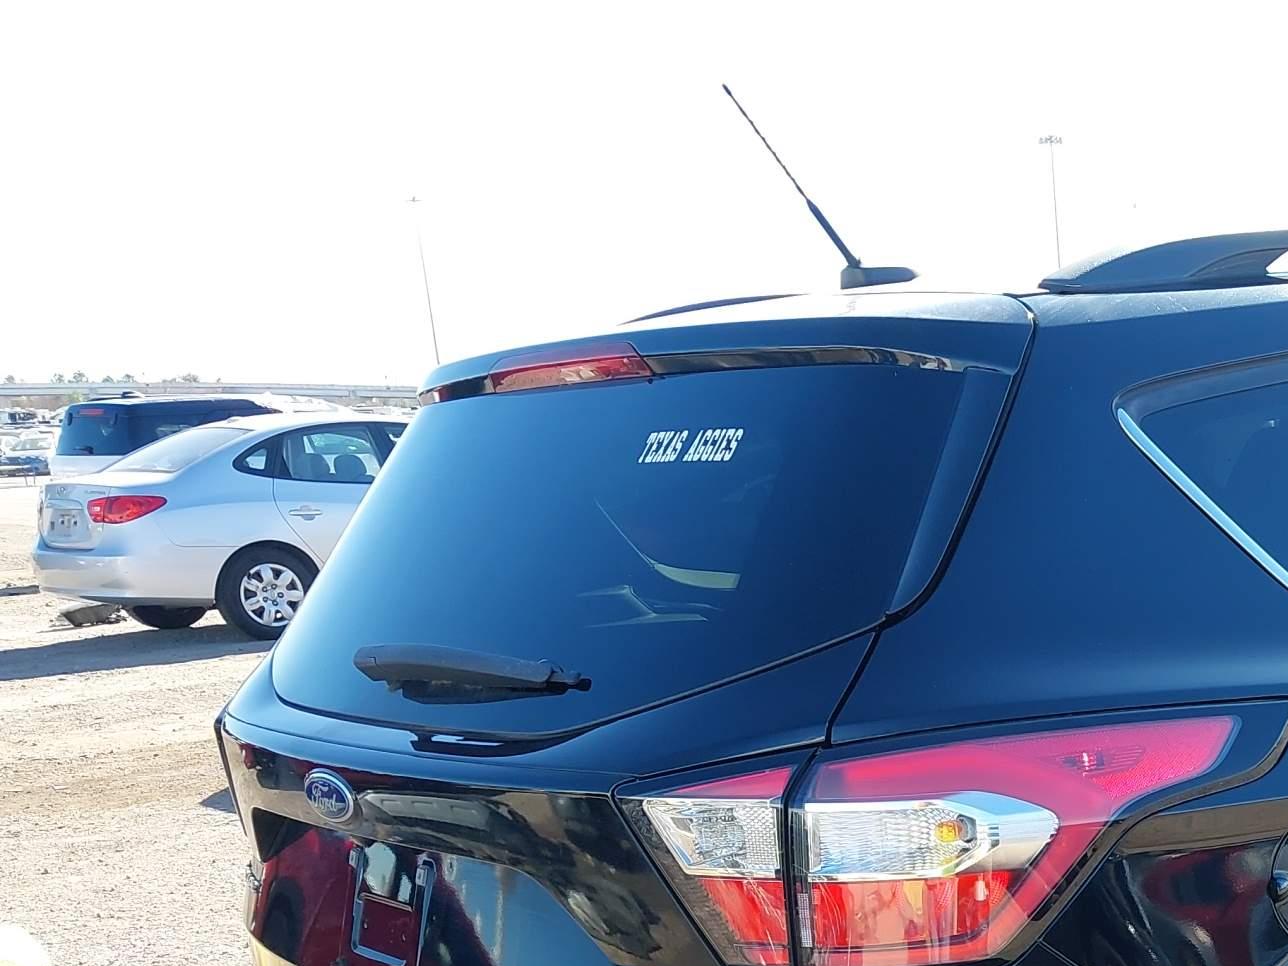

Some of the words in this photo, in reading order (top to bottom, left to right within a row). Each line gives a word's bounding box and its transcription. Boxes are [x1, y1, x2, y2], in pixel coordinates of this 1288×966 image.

[637, 430, 690, 464] TEXAS
[681, 428, 745, 462] AGGIES
[311, 783, 339, 812] Ford
